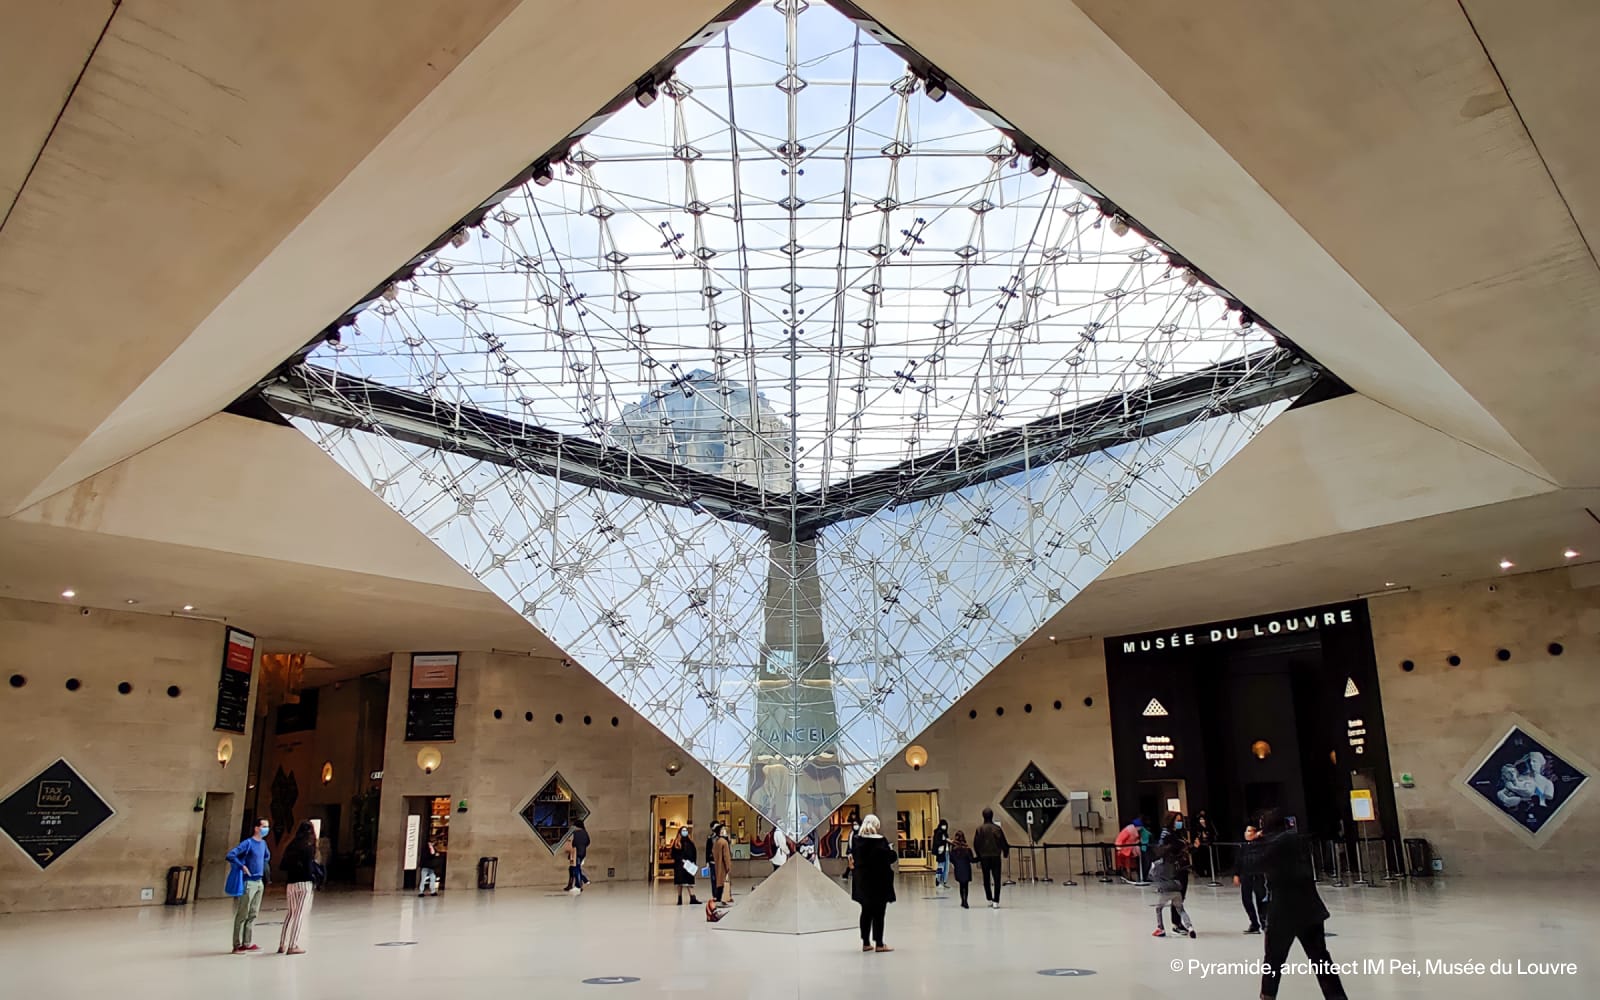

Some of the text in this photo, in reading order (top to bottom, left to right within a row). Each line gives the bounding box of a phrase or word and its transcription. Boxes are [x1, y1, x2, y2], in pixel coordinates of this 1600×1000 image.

[1123, 610, 1353, 653] MUSÉE DU LOUVRE
[1013, 798, 1057, 808] CHANGE
